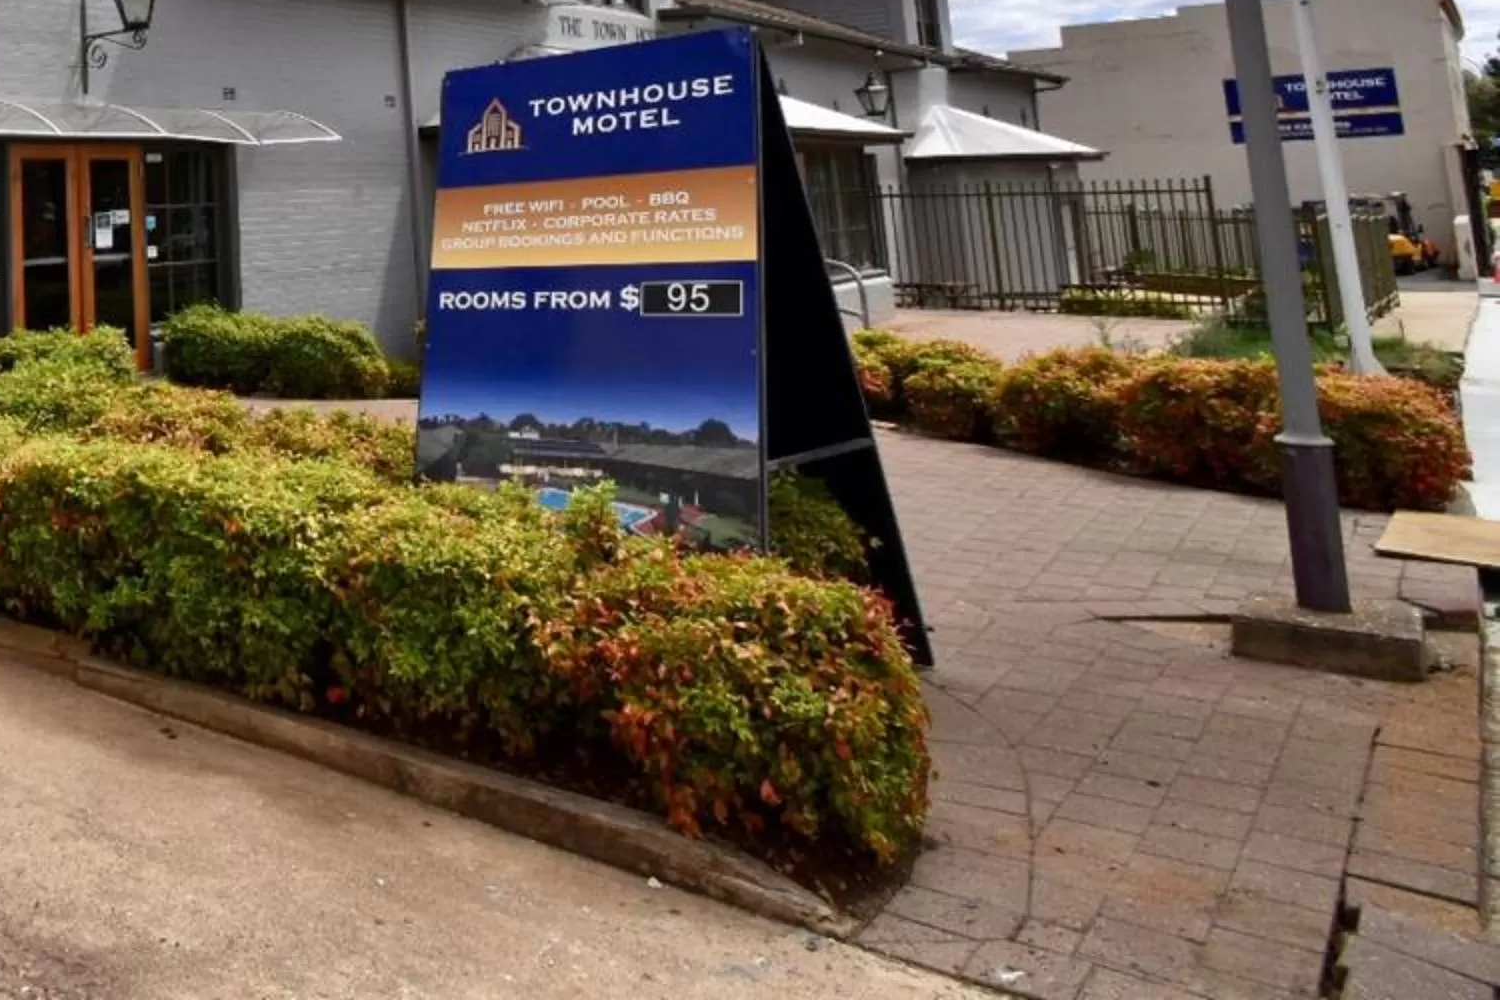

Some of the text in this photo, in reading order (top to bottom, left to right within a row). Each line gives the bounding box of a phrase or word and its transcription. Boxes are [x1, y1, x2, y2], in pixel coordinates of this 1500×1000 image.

[558, 15, 585, 37] THE
[592, 19, 627, 41] TOWN
[529, 75, 734, 117] TOWNHOUSE
[572, 108, 680, 136] MOTEL
[483, 191, 690, 217] FREE WIFI POOL BBQ
[461, 208, 717, 233] NETFLIX CORPORATE RATES
[441, 225, 744, 250] GROUP BOOKINGS AND FUNCTIONS
[439, 283, 711, 312] ROOMS FROM $ 95
